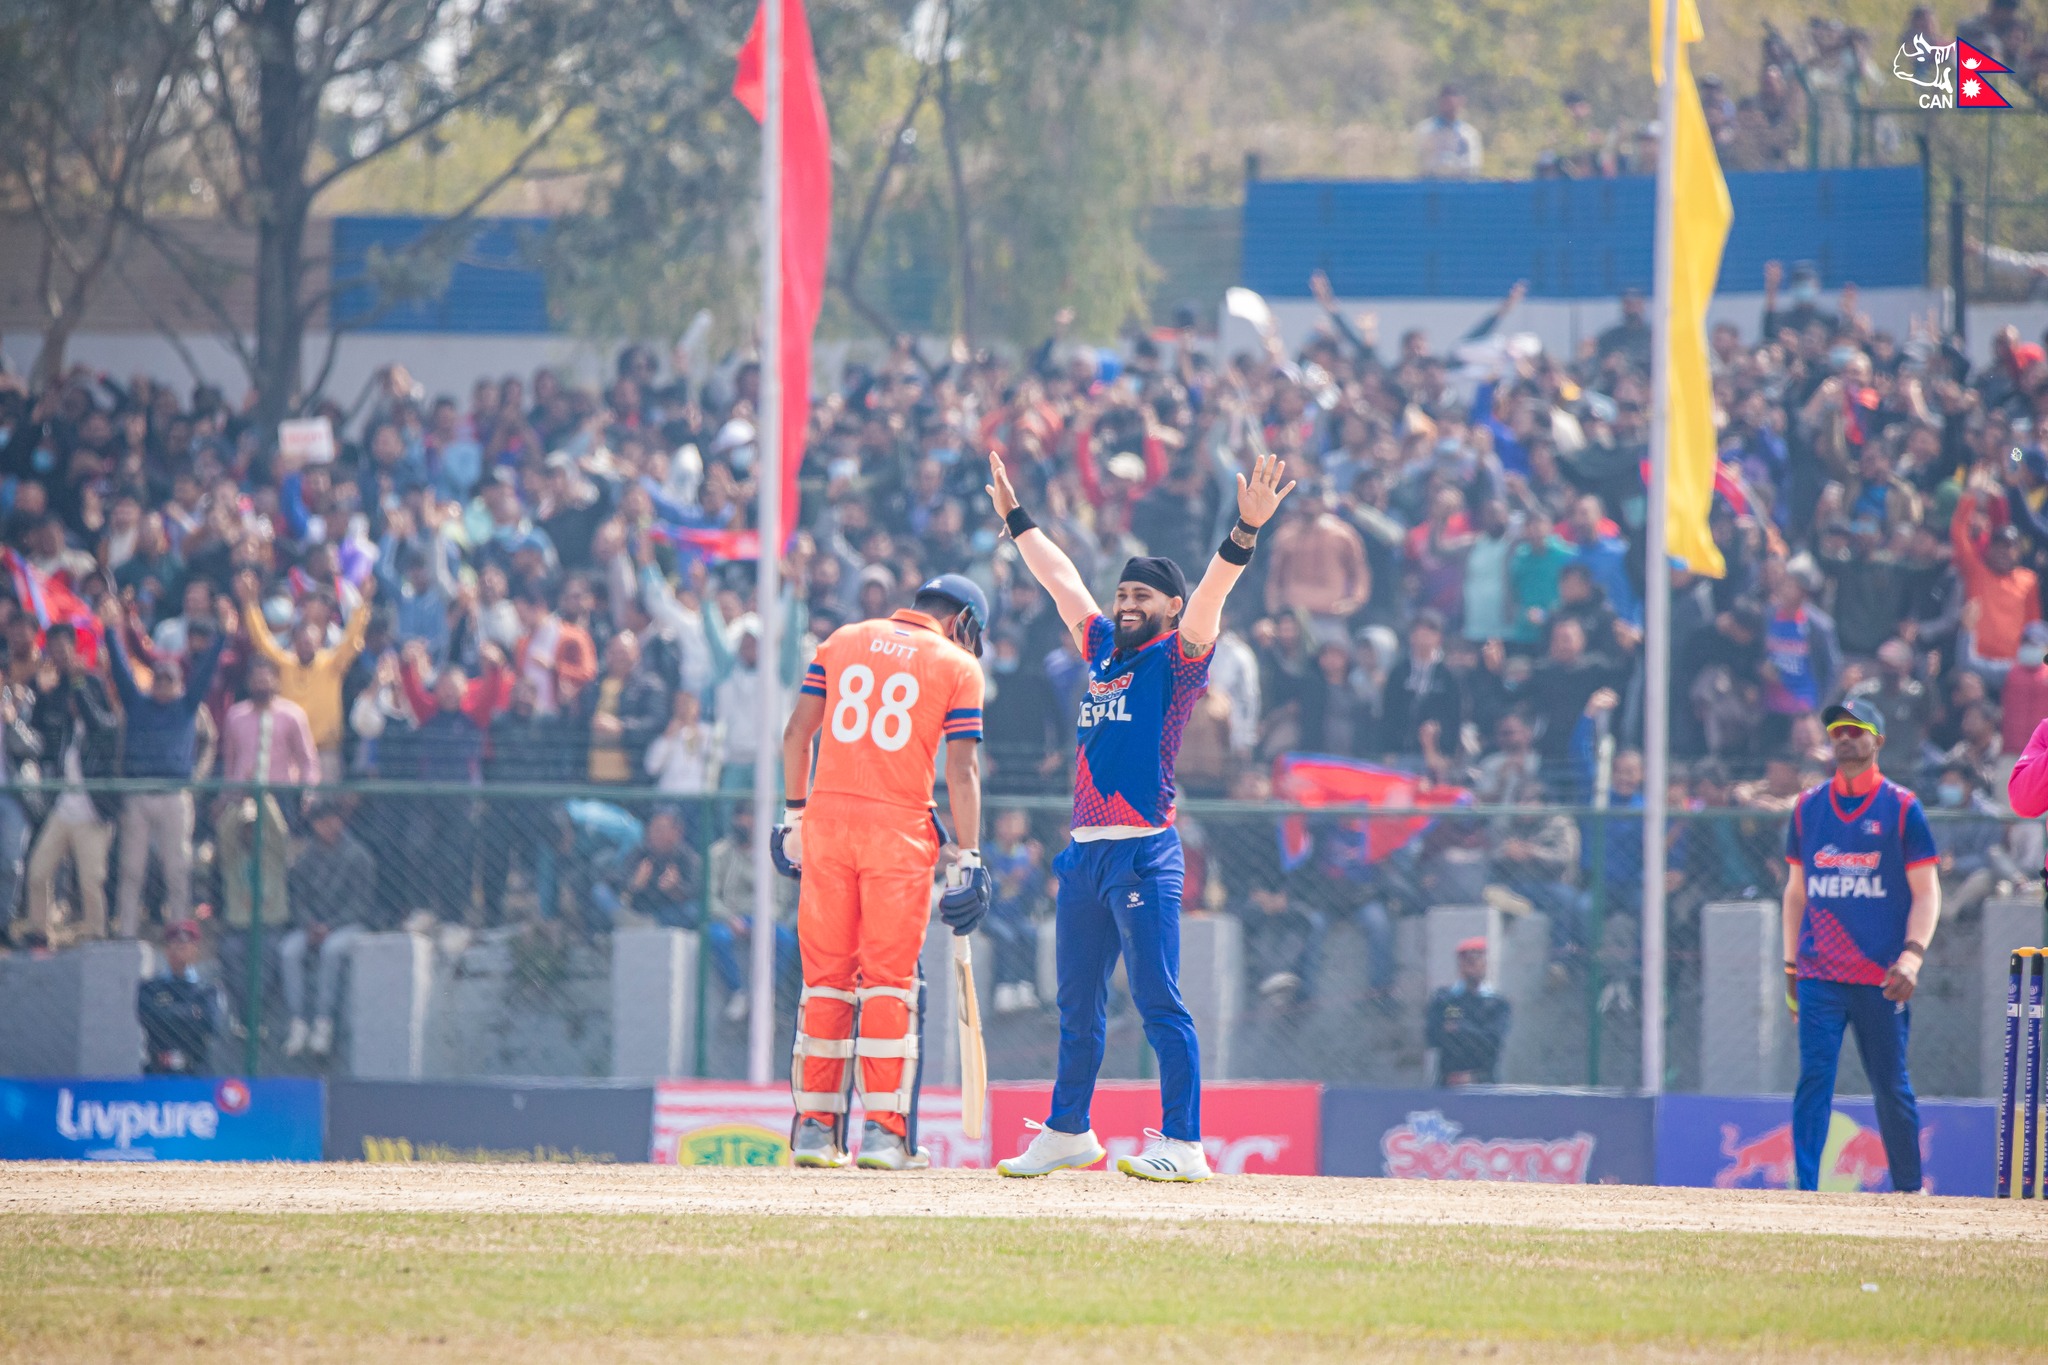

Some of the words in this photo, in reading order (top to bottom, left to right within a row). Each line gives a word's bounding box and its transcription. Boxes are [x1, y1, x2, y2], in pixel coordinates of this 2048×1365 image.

[869, 639, 918, 660] DUTT
[831, 663, 920, 752] 88
[1077, 695, 1132, 727] EPAL
[1807, 875, 1887, 898] NEPAL
